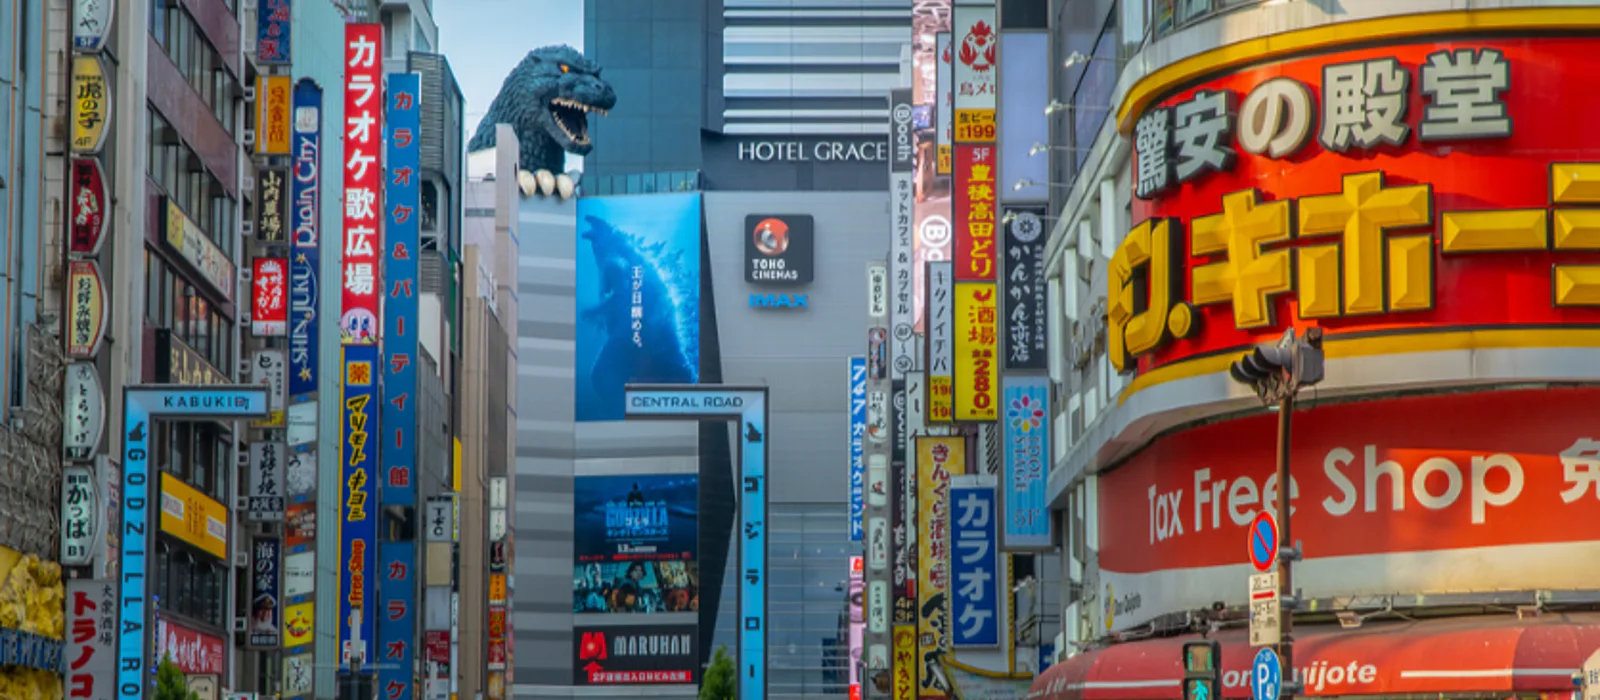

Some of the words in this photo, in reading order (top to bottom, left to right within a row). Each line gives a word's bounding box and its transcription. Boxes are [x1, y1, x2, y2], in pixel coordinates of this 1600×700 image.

[959, 82, 995, 96] 鳥メ
[893, 103, 912, 162] Booth
[1136, 48, 1513, 200] 驚安の殿堂
[345, 35, 375, 295] カラオケ歌広場
[738, 142, 809, 161] HOTEL
[814, 142, 887, 161] GRACE
[972, 147, 990, 161] 5F
[967, 164, 995, 277] 豊後高田どり
[752, 259, 786, 269] TOHO
[752, 270, 798, 279] CINEMAS
[748, 294, 809, 307] IMAX
[896, 269, 909, 314] カプセル
[967, 305, 995, 345] 酒場
[629, 396, 697, 407] CENTRAL
[702, 396, 743, 407] ROAD
[974, 360, 989, 409] 280
[346, 394, 370, 521] マツモトキヨシ
[1148, 483, 1183, 545] Tax
[1194, 468, 1300, 532] Free
[1322, 444, 1525, 525] Shop
[123, 448, 146, 635] GODZILLA
[956, 493, 992, 639] カラオケ
[98, 584, 113, 646] 大衆酒場
[386, 561, 406, 700] カラオケ
[70, 591, 97, 698] トラノコ
[614, 635, 690, 655] MARUHAN
[1292, 661, 1378, 692] uijote
